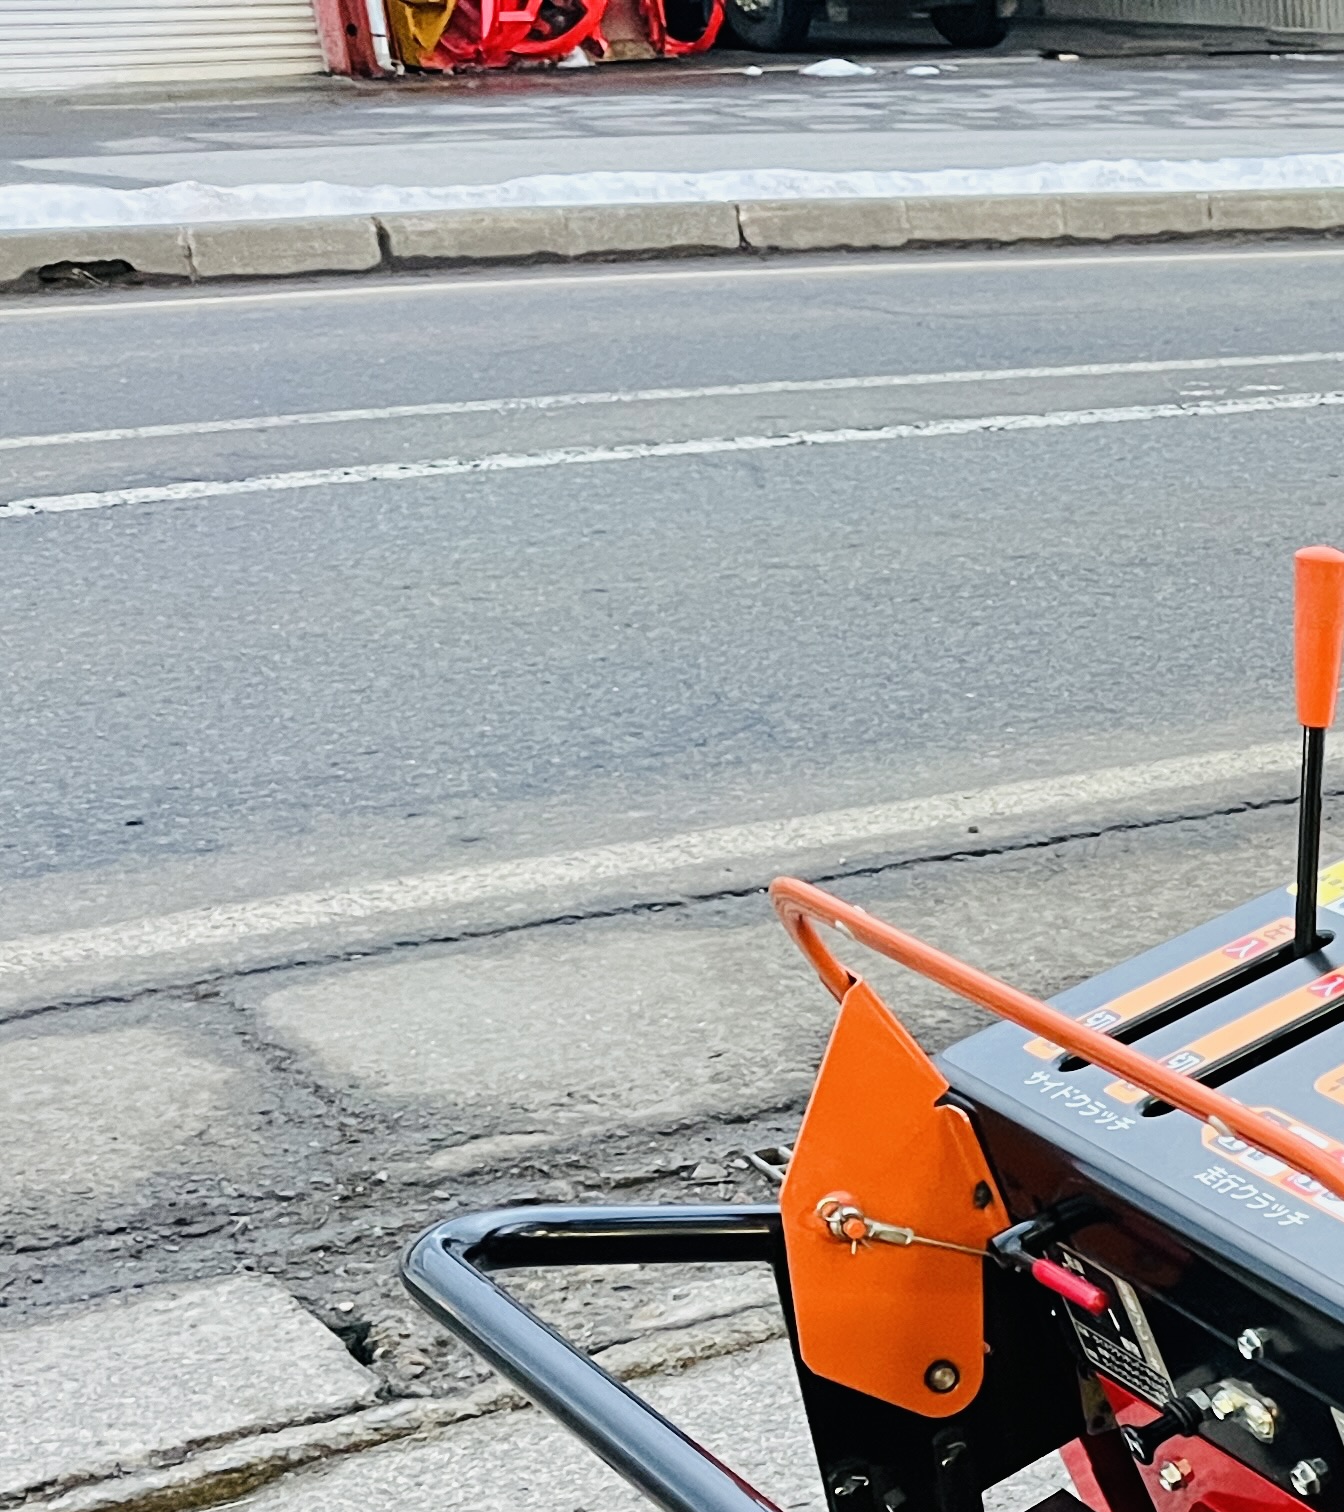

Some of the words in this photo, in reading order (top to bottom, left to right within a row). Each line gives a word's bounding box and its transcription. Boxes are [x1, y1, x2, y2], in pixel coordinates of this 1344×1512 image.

[1224, 939, 1259, 959] 入
[1309, 977, 1344, 997] 入
[1167, 1051, 1201, 1073] 切
[1023, 1070, 1136, 1132] サイドクラッチ
[1193, 1165, 1310, 1227] 走行クラッチ
